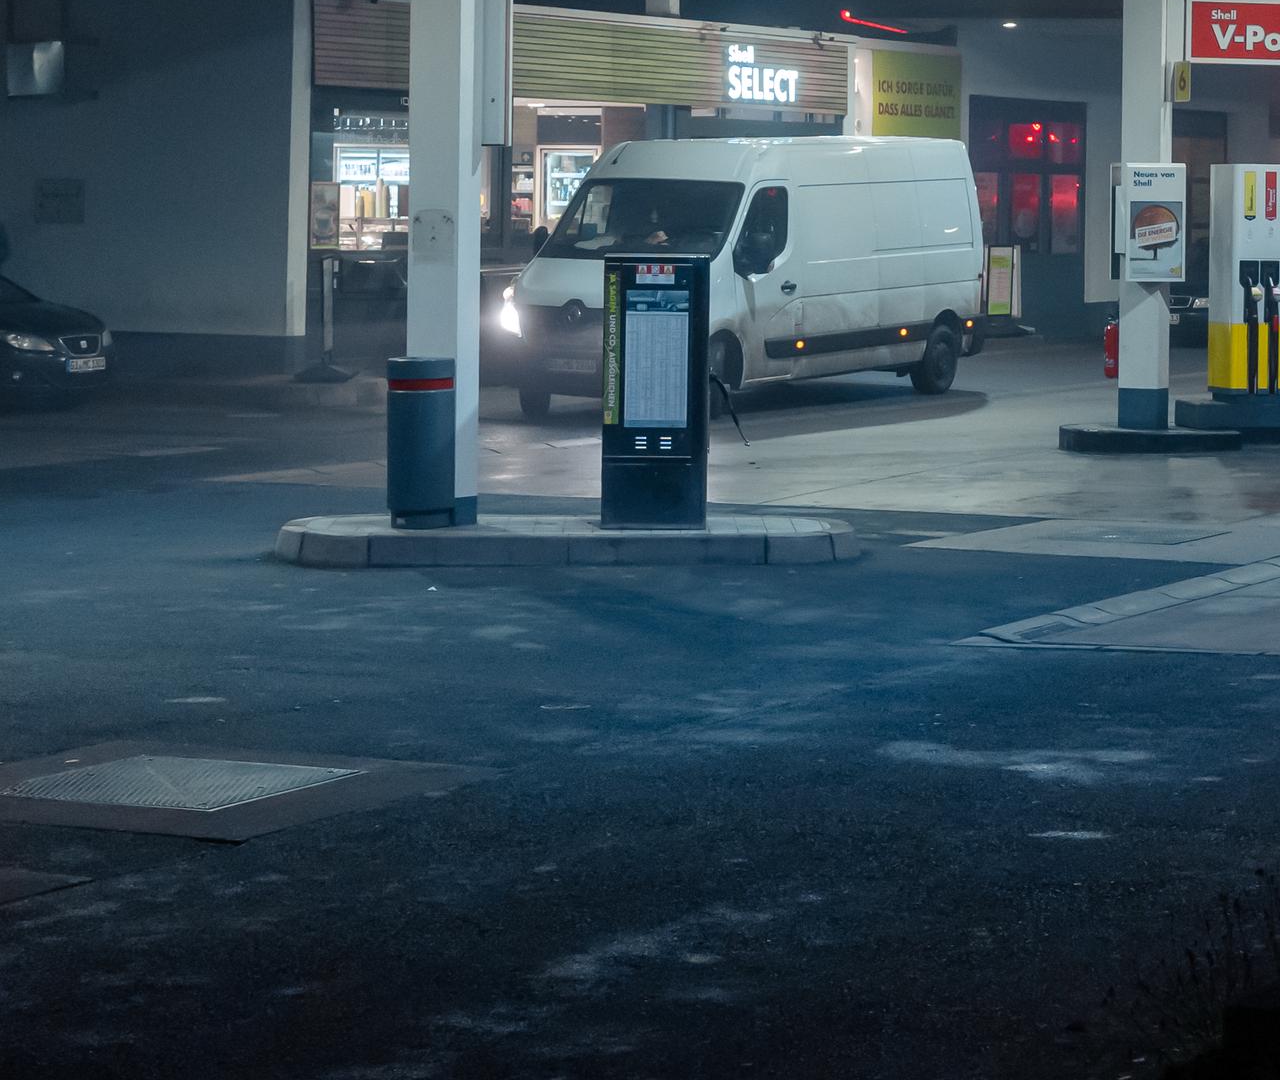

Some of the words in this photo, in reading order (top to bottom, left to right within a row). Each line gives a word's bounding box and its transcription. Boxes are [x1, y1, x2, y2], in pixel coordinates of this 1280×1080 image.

[1211, 10, 1237, 20] Shell
[728, 45, 754, 63] Shell
[728, 65, 799, 102] SELECT
[878, 80, 893, 93] ICH
[896, 81, 924, 95] SORGE
[1179, 70, 1186, 91] 6
[878, 102, 899, 116] DASS
[608, 314, 616, 334] UND
